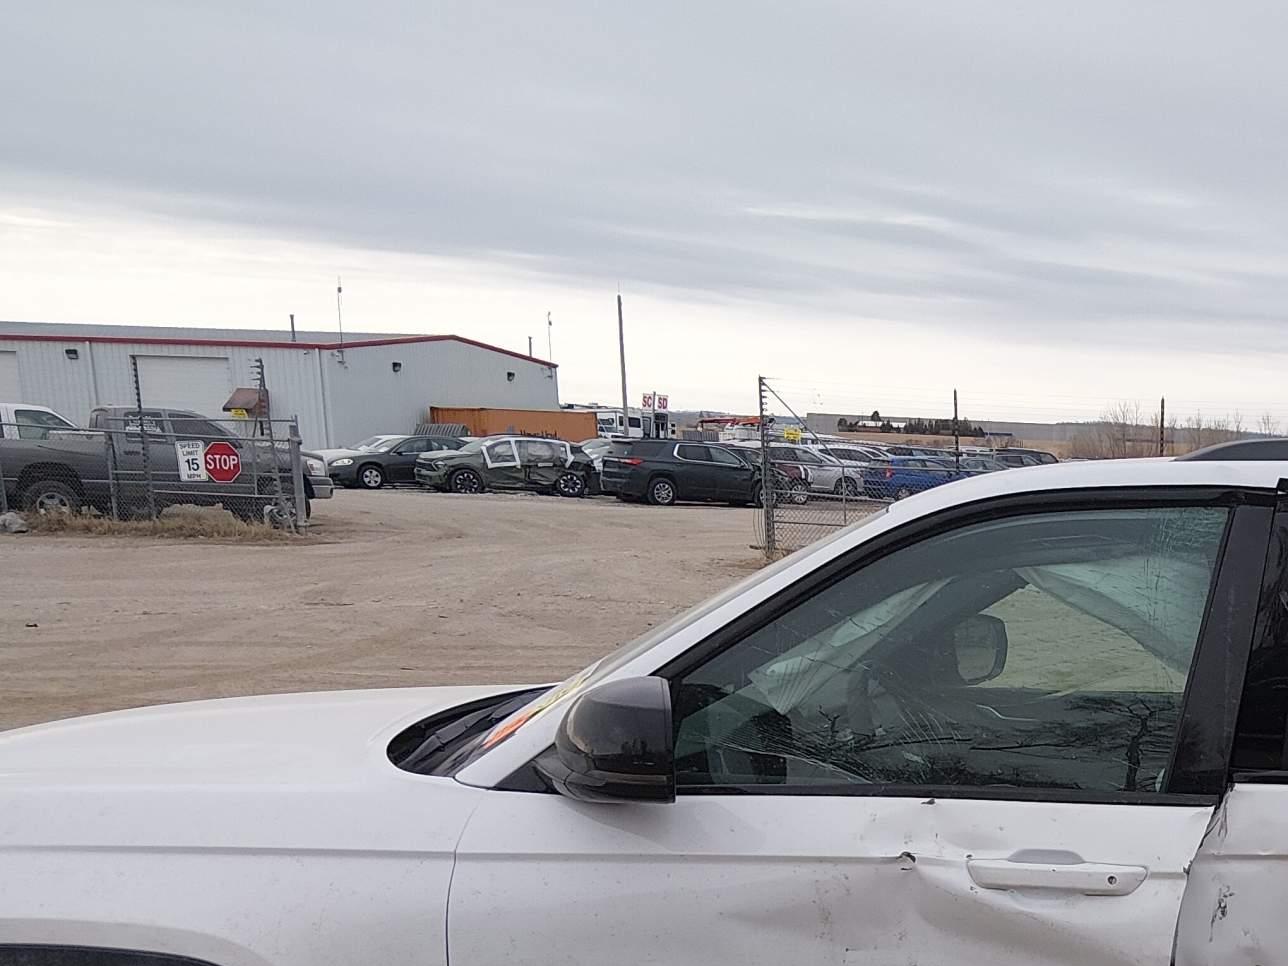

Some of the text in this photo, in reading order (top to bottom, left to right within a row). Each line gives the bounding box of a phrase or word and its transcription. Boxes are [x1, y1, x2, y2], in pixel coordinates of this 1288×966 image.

[642, 395, 652, 407] SC
[657, 397, 668, 409] SD
[185, 458, 200, 471] 15
[206, 454, 238, 470] STOP
